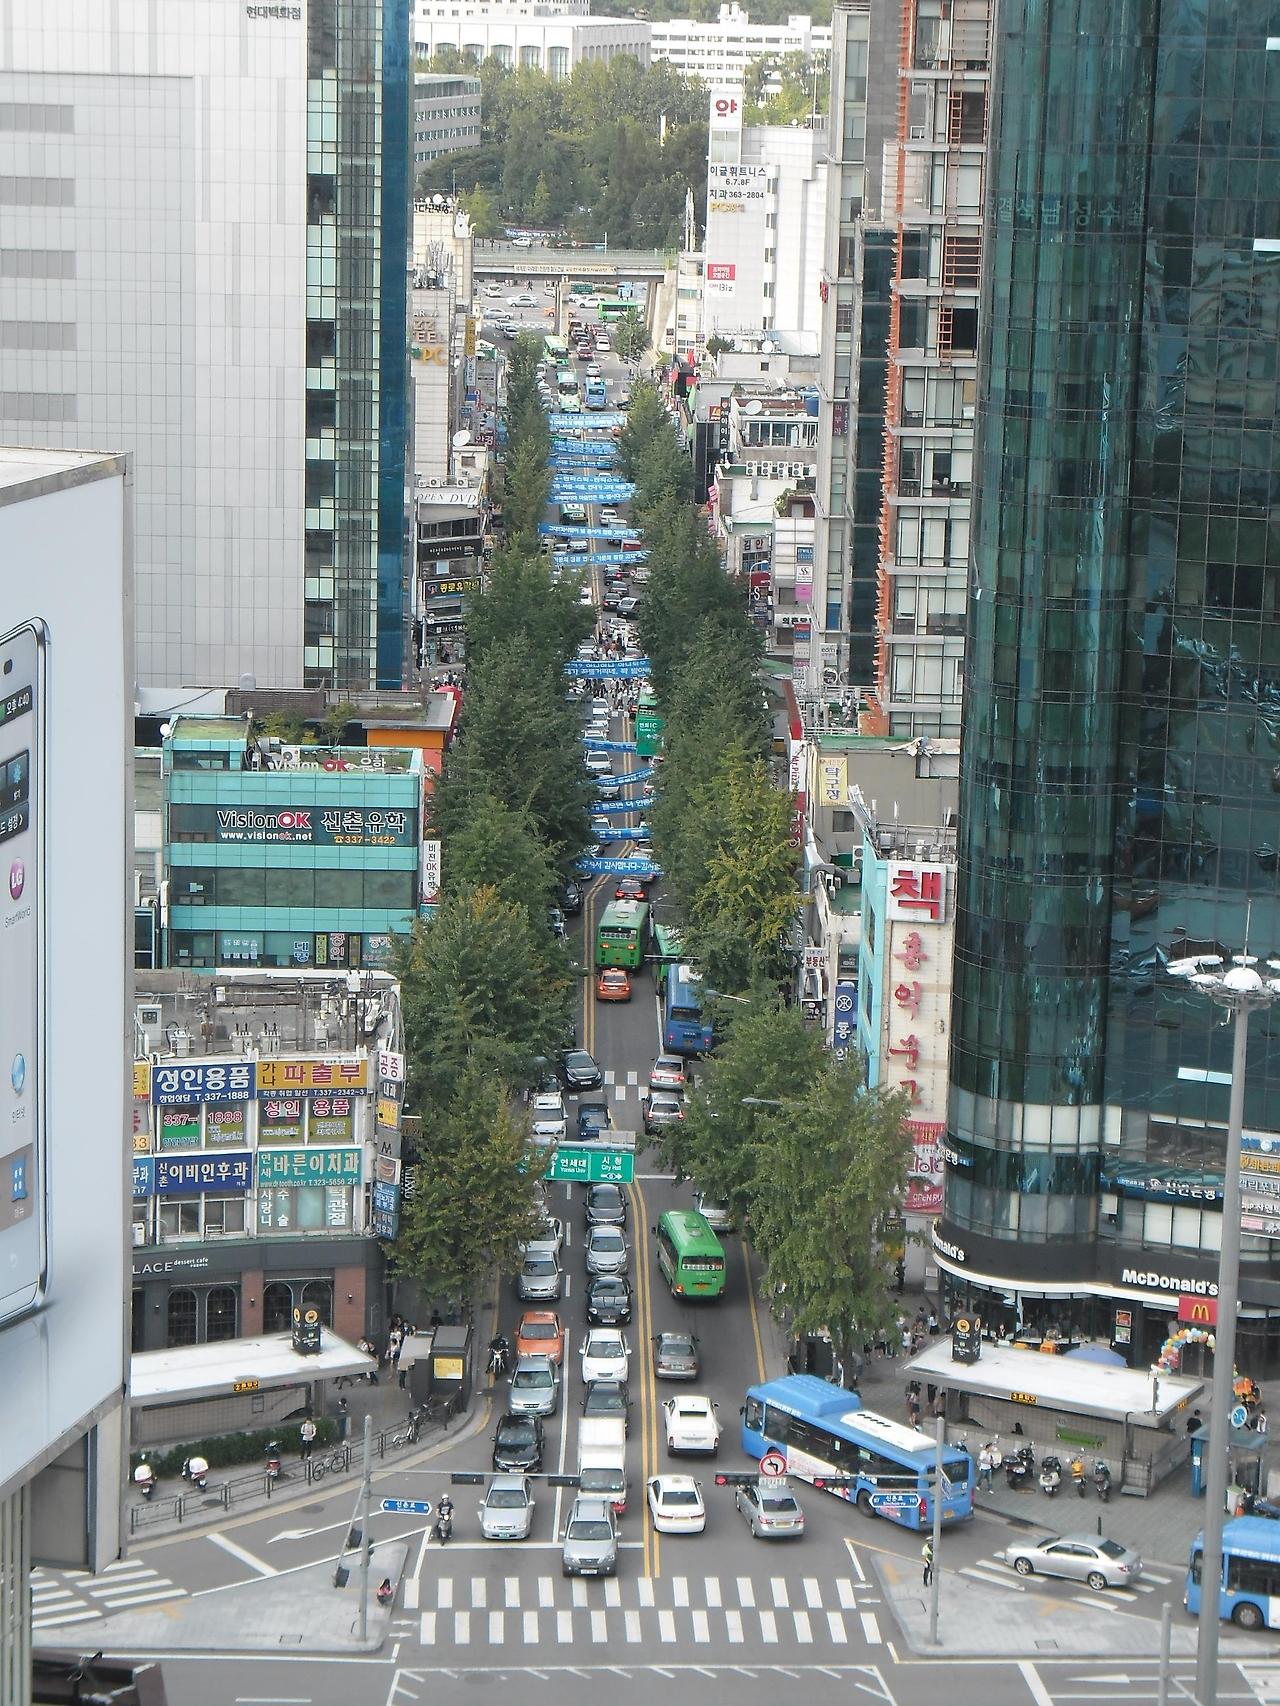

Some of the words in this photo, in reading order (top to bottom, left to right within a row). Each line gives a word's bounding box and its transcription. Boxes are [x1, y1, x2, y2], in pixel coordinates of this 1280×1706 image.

[246, 6, 301, 20] 현대백화점
[710, 166, 766, 177] 이글휘트니스
[729, 191, 764, 199] 363-2804
[449, 494, 477, 503] DVD
[6, 699, 17, 715] 오후
[217, 810, 312, 829] VisionOK
[320, 811, 406, 833] 신촌유학
[221, 831, 312, 841] www.visionok.net
[345, 835, 396, 845] 337-3422
[11, 869, 23, 889] LG
[890, 870, 941, 920] 책
[805, 956, 825, 968] 부동산
[284, 1063, 360, 1084] 파출부
[380, 1054, 398, 1078] 공증
[156, 1066, 250, 1093] 성인용품
[195, 1091, 249, 1102] T.337-1888
[313, 1088, 364, 1096] T.337-2342-3
[264, 1100, 300, 1117] 성인
[313, 1099, 349, 1117] 용품
[273, 1152, 360, 1176] 바른이치과
[560, 1158, 587, 1168] 연세대
[602, 1156, 622, 1165] 시청
[158, 1162, 168, 1187] 신촌
[169, 1162, 248, 1184] 이비인후과
[347, 1178, 358, 1186] 2F
[260, 1189, 272, 1227] 사랑니
[174, 1258, 195, 1266] dessert
[1122, 1269, 1219, 1296] McDonald's
